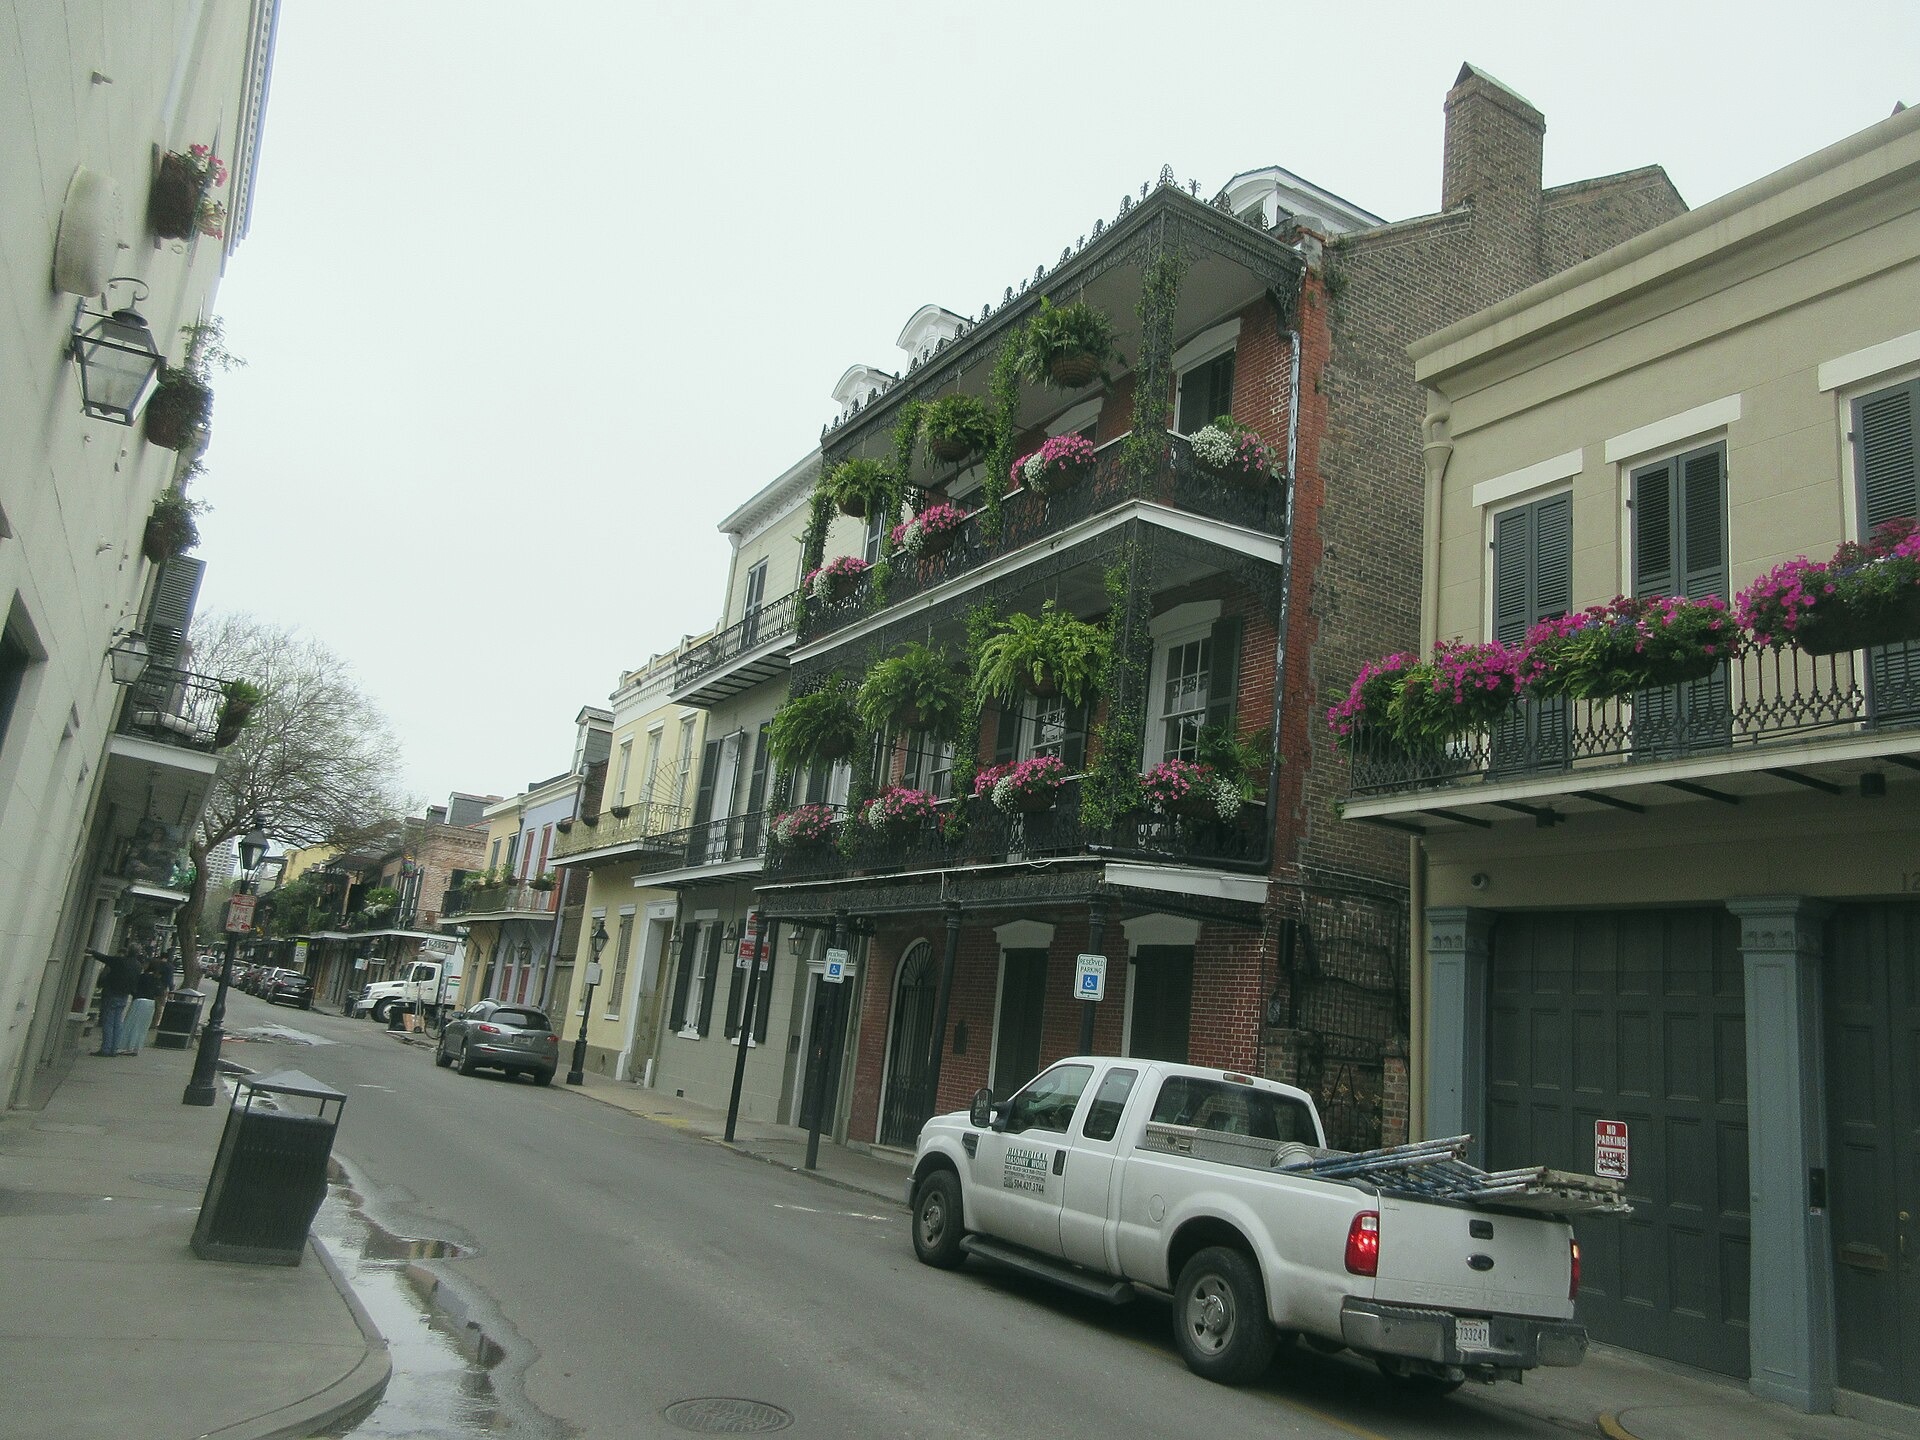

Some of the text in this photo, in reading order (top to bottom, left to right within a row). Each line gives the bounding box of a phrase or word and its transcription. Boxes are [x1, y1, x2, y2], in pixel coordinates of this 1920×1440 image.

[1079, 958, 1103, 966] RESERVED
[1080, 966, 1102, 974] PARKING
[1606, 1125, 1616, 1135] NO
[1597, 1134, 1626, 1147] PARKING
[1007, 1147, 1048, 1161] HISTORICAL
[1005, 1154, 1047, 1170] MASONRY WORK
